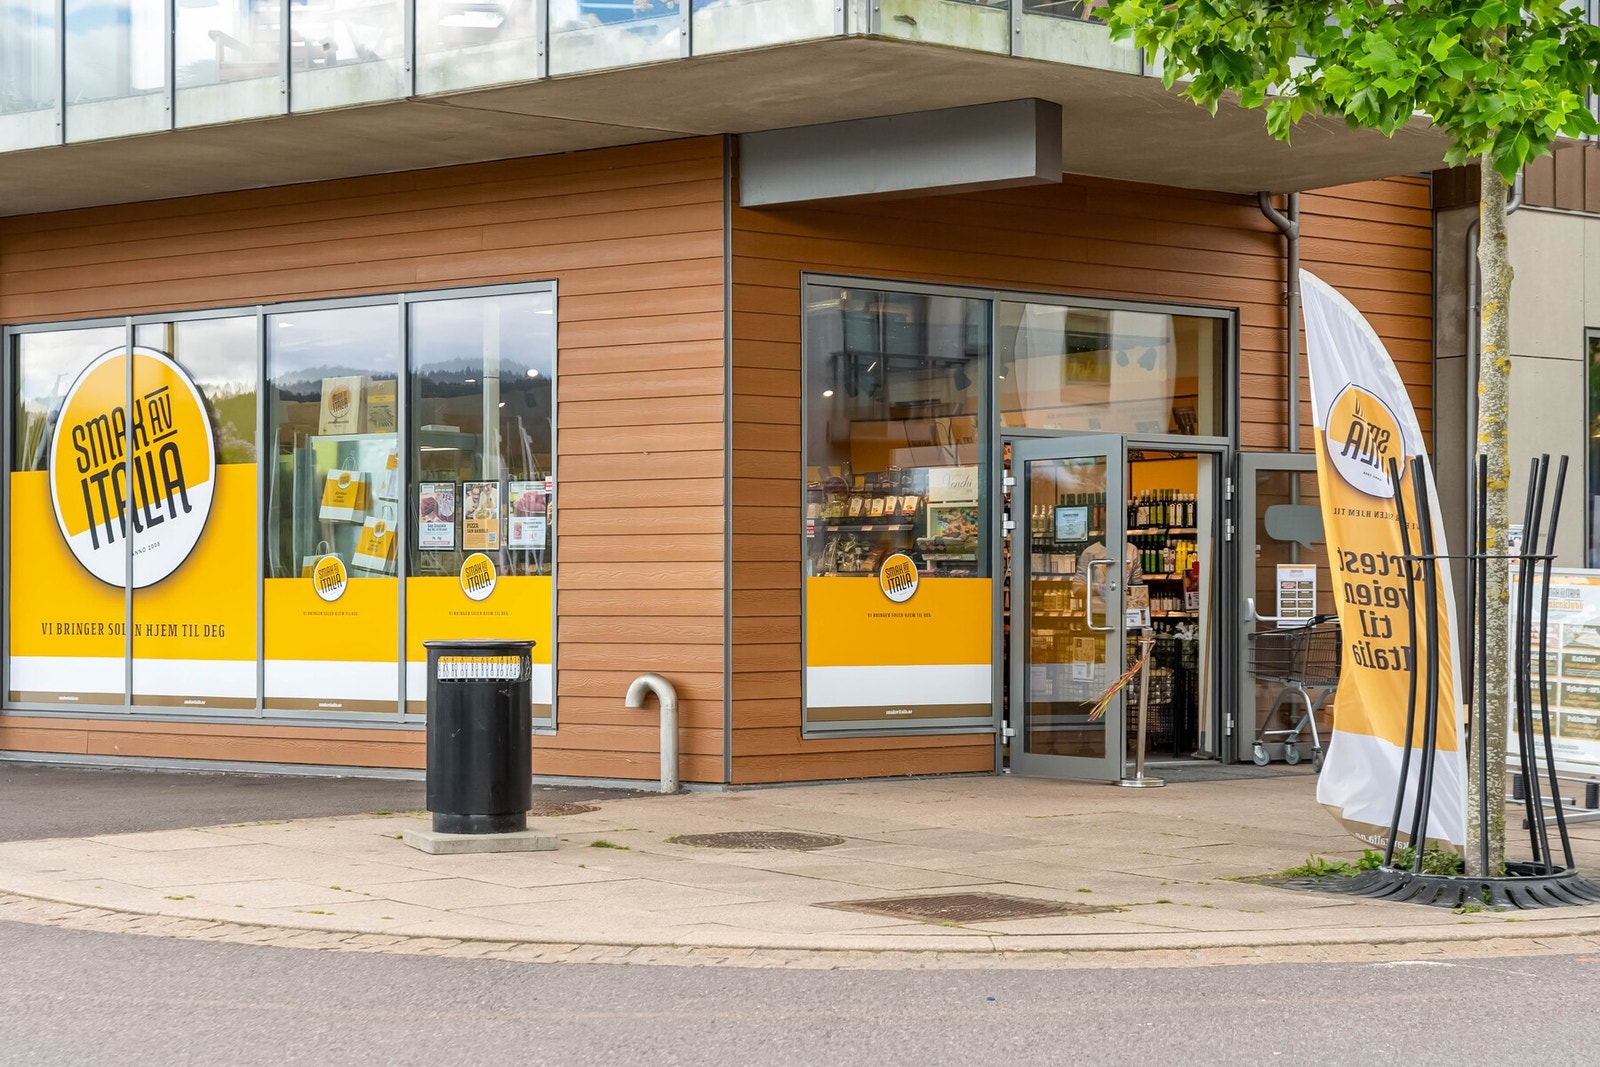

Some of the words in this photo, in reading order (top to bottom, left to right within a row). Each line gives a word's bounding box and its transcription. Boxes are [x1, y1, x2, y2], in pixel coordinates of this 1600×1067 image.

[72, 399, 150, 474] SMAK
[148, 394, 173, 436] AV
[81, 441, 192, 551] ITALIA
[320, 573, 343, 594] ITALIA
[467, 571, 492, 593] ITALIA
[887, 573, 914, 595] ITALIA
[41, 622, 53, 636] VI
[56, 622, 104, 636] BRINGER
[108, 622, 142, 637] SOLN
[146, 624, 178, 637] HJEM
[182, 624, 199, 637] TIL
[204, 624, 225, 638] DEG
